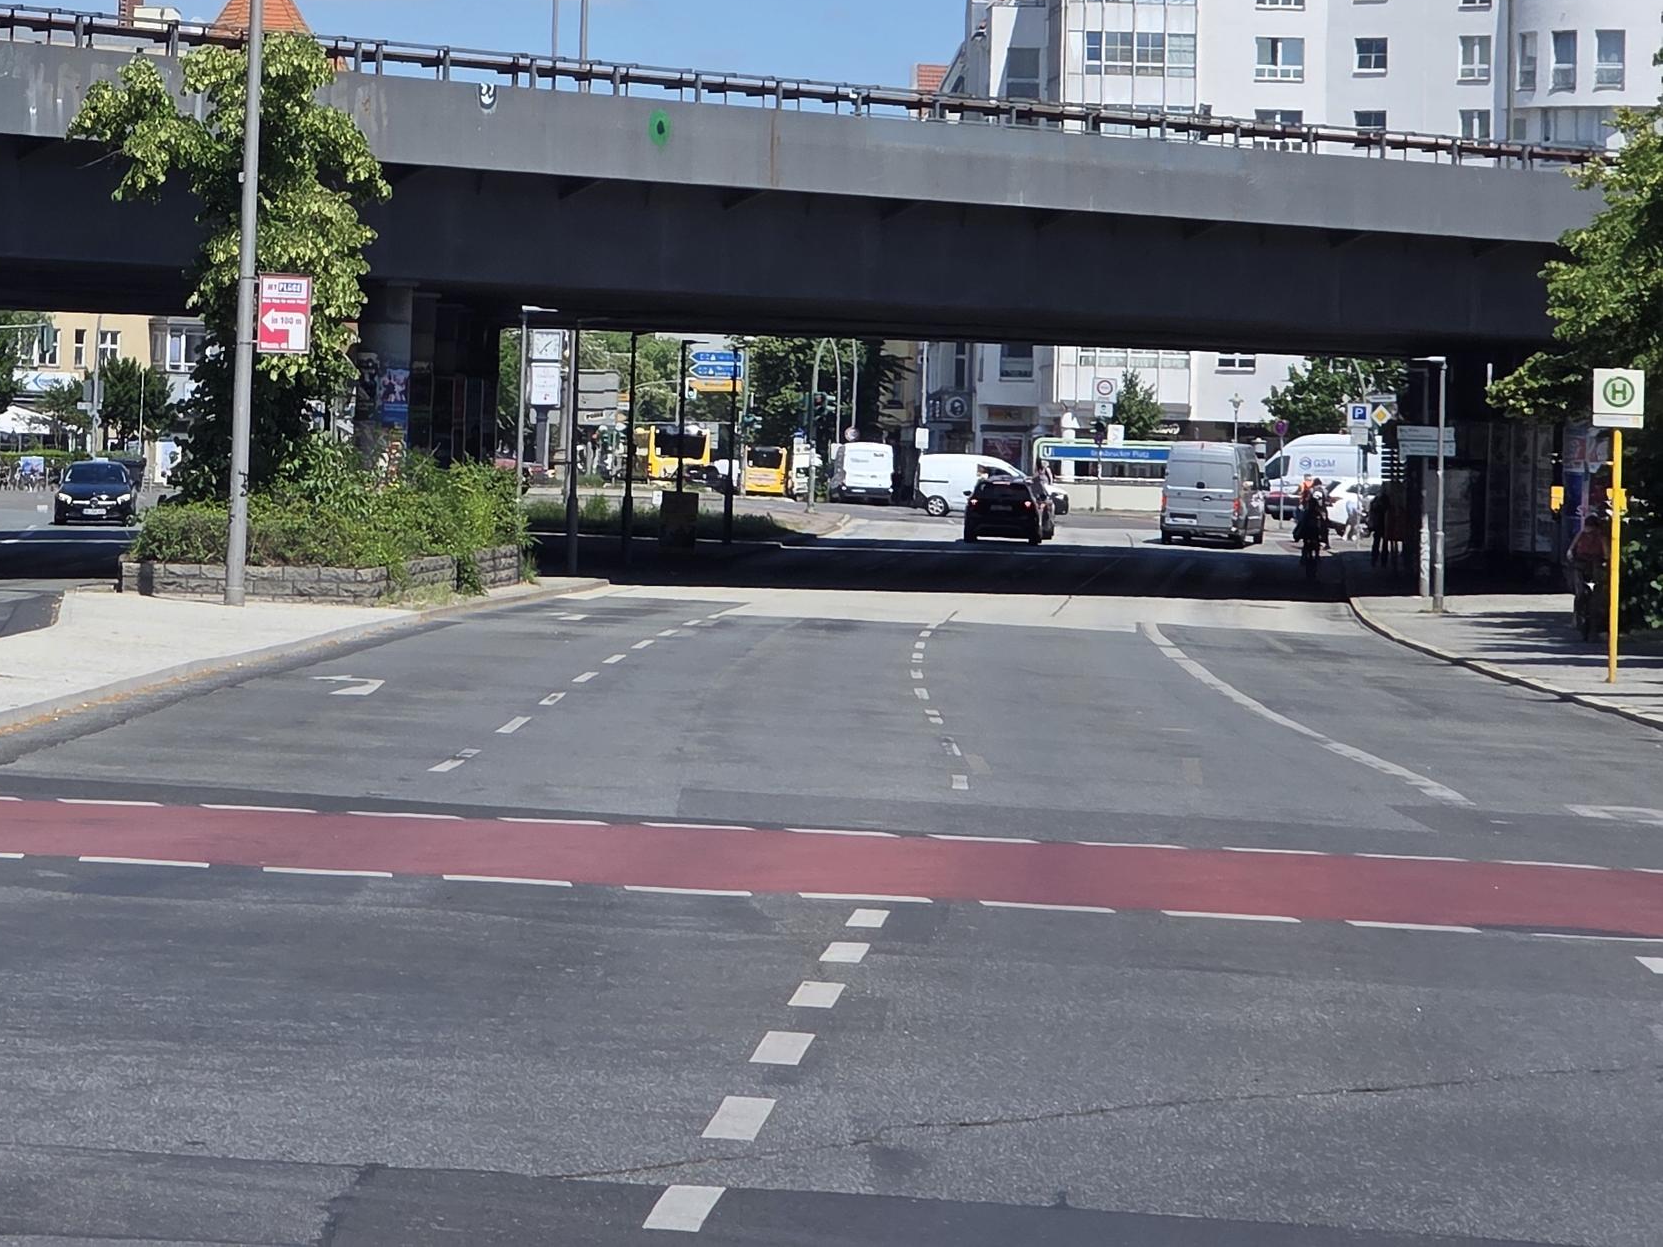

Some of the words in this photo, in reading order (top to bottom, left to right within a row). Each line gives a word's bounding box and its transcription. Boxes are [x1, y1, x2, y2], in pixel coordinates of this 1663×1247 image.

[1611, 383, 1627, 401] H
[1354, 407, 1364, 419] P
[1043, 447, 1052, 457] U
